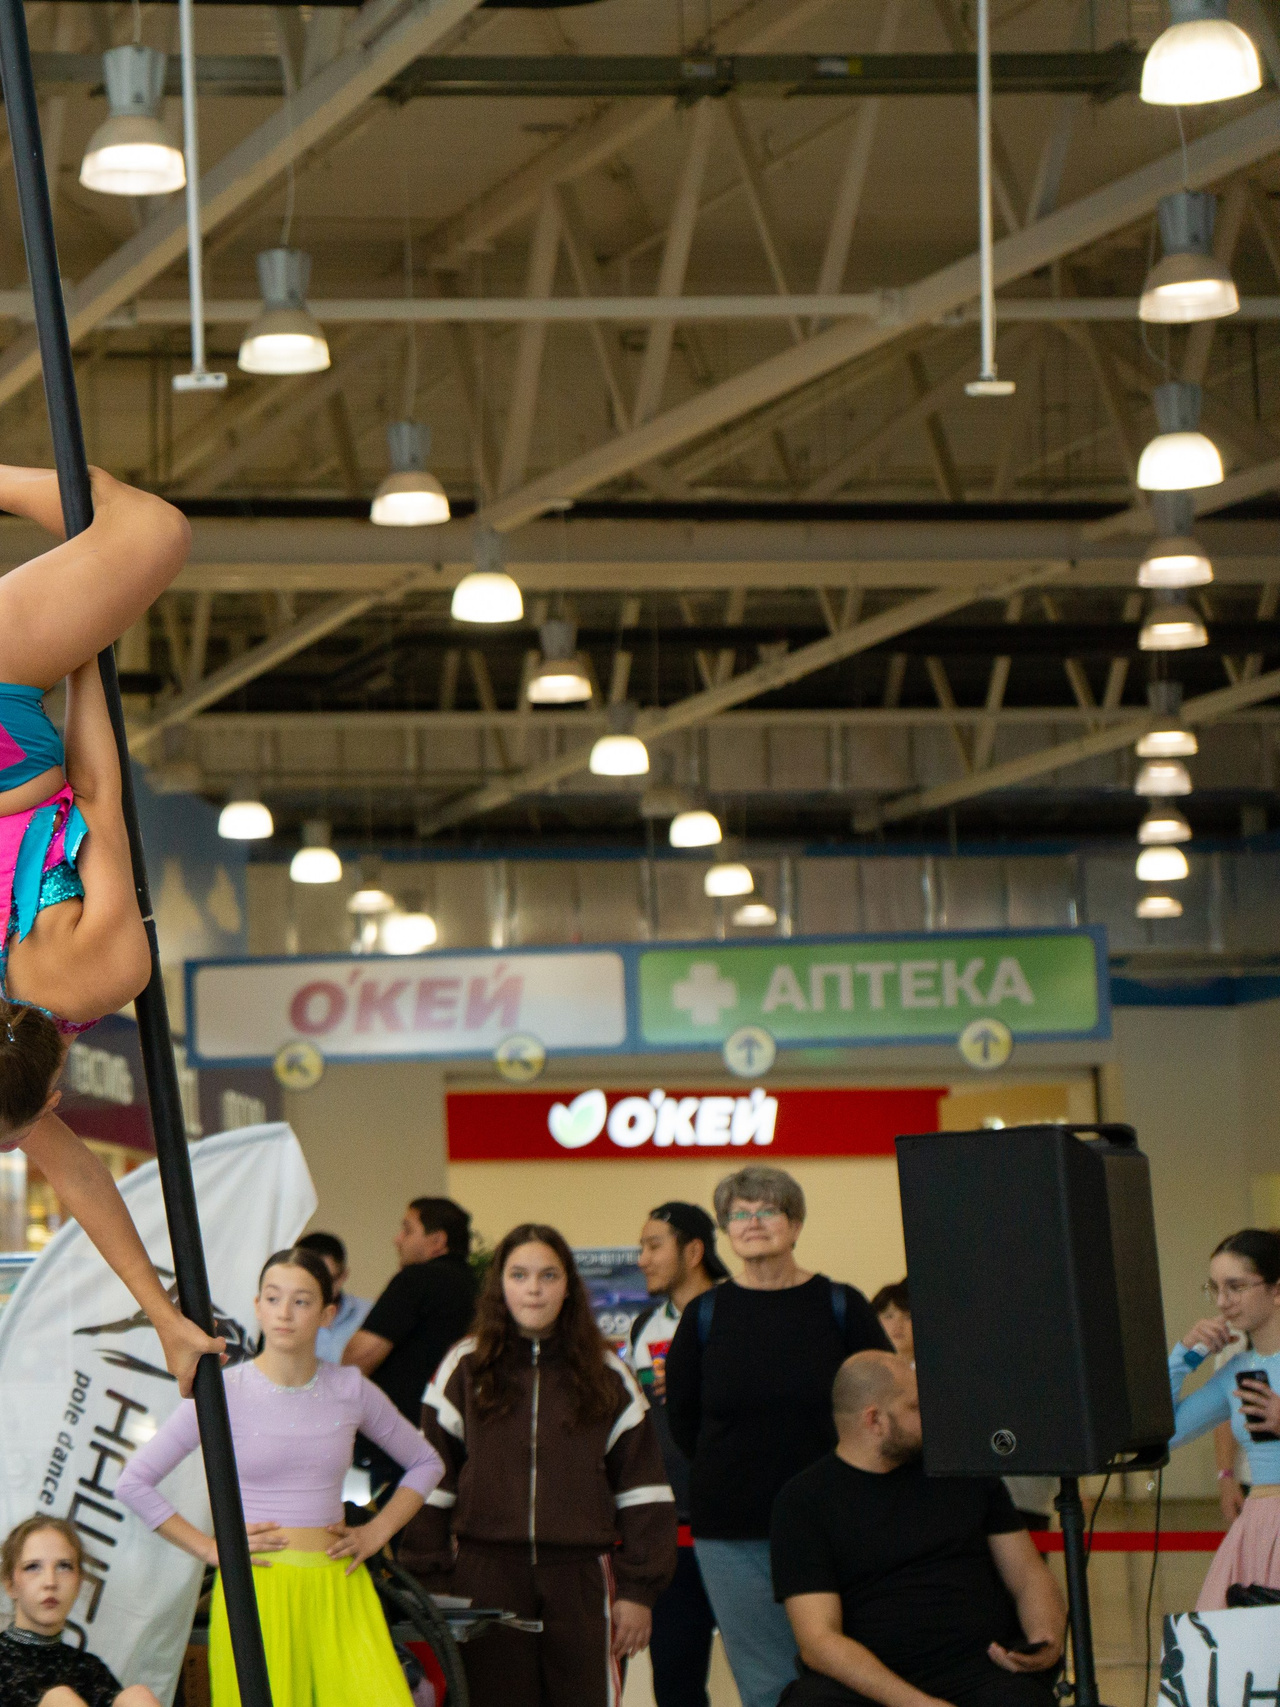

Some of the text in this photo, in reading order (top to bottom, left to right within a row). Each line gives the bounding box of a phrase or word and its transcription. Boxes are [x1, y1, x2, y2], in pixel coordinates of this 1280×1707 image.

[761, 956, 1037, 1014] АПТЕКА
[39, 1369, 92, 1507] pole dance
